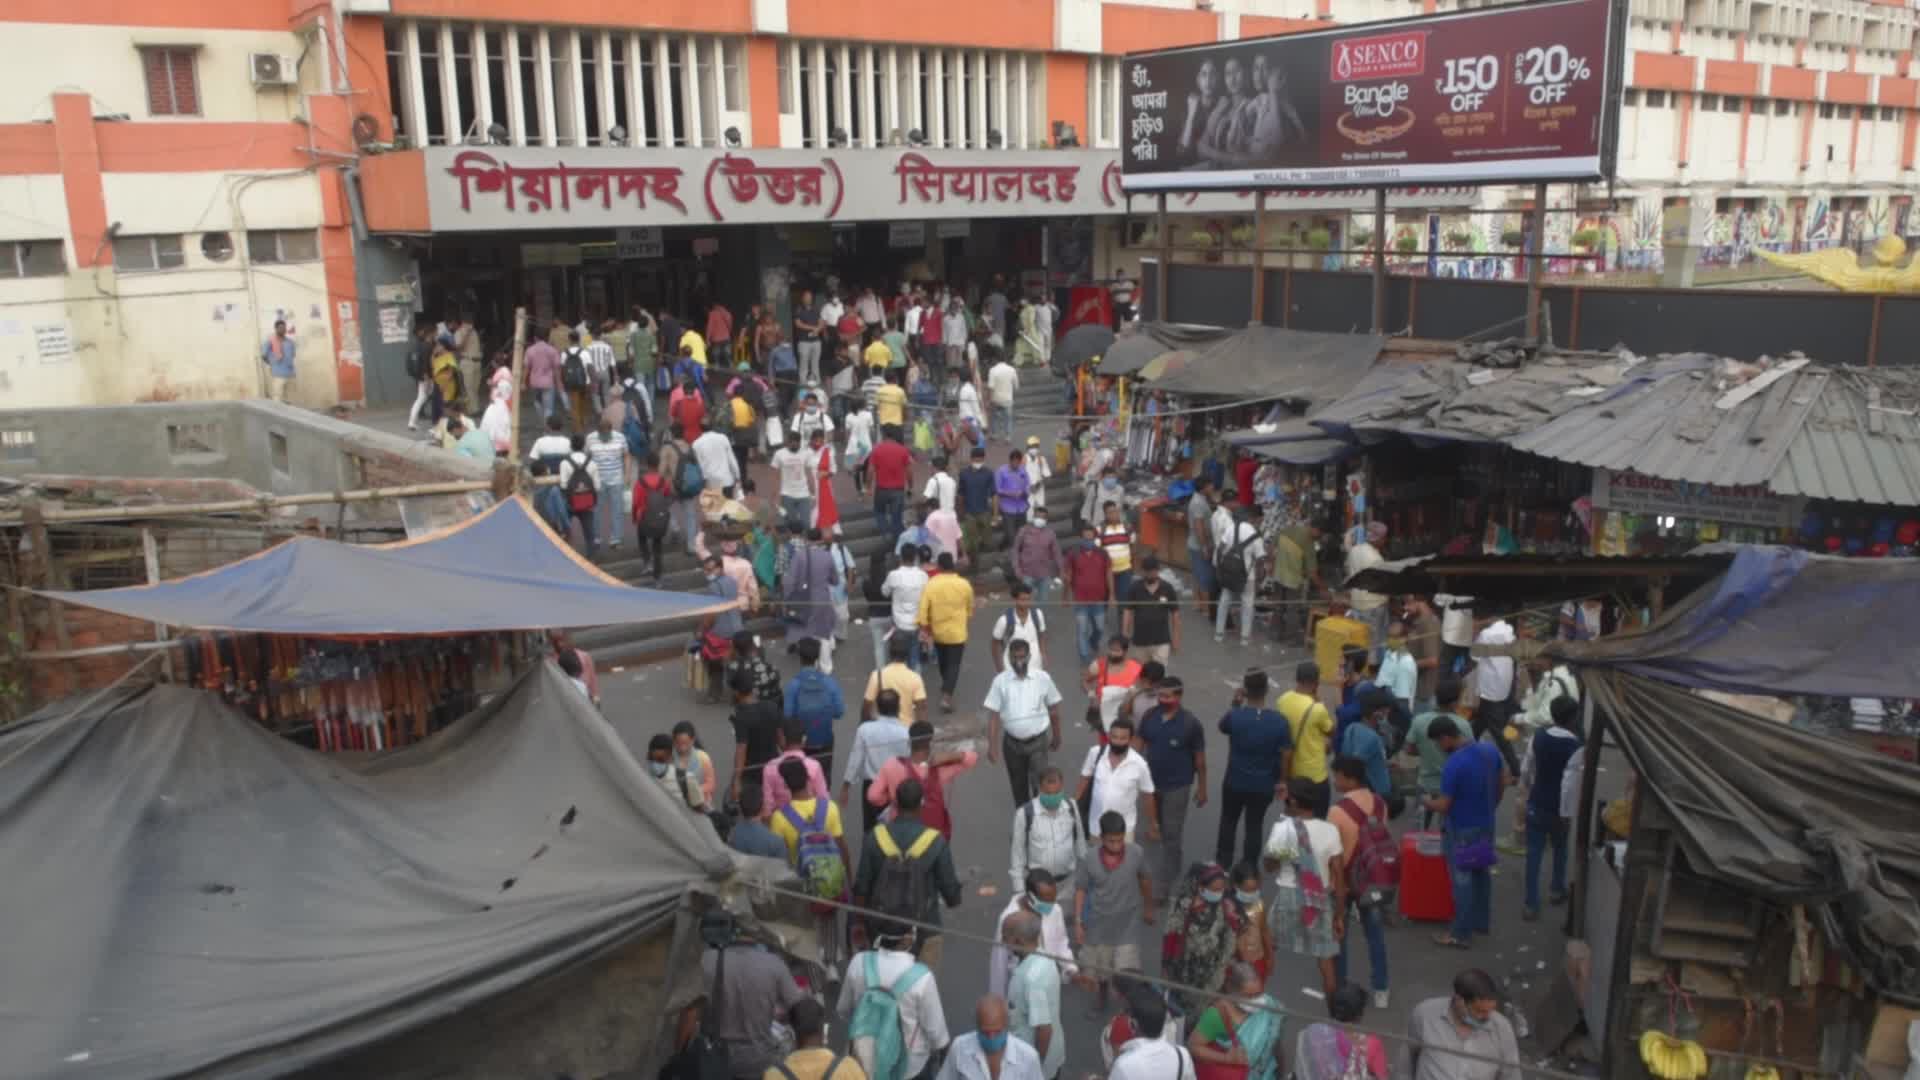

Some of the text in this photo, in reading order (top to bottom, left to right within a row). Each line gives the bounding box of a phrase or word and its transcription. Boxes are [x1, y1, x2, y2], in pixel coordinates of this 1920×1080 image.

[1353, 40, 1418, 65] SENCO
[1524, 45, 1591, 85] 20%
[1132, 90, 1168, 110] আমরা
[1344, 80, 1408, 117] Bangle
[1132, 112, 1164, 140] চুড়িও
[447, 150, 845, 221] শিয়ালদহ (উত্তর)
[896, 153, 1080, 205] सियालदह
[631, 229, 649, 240] NO
